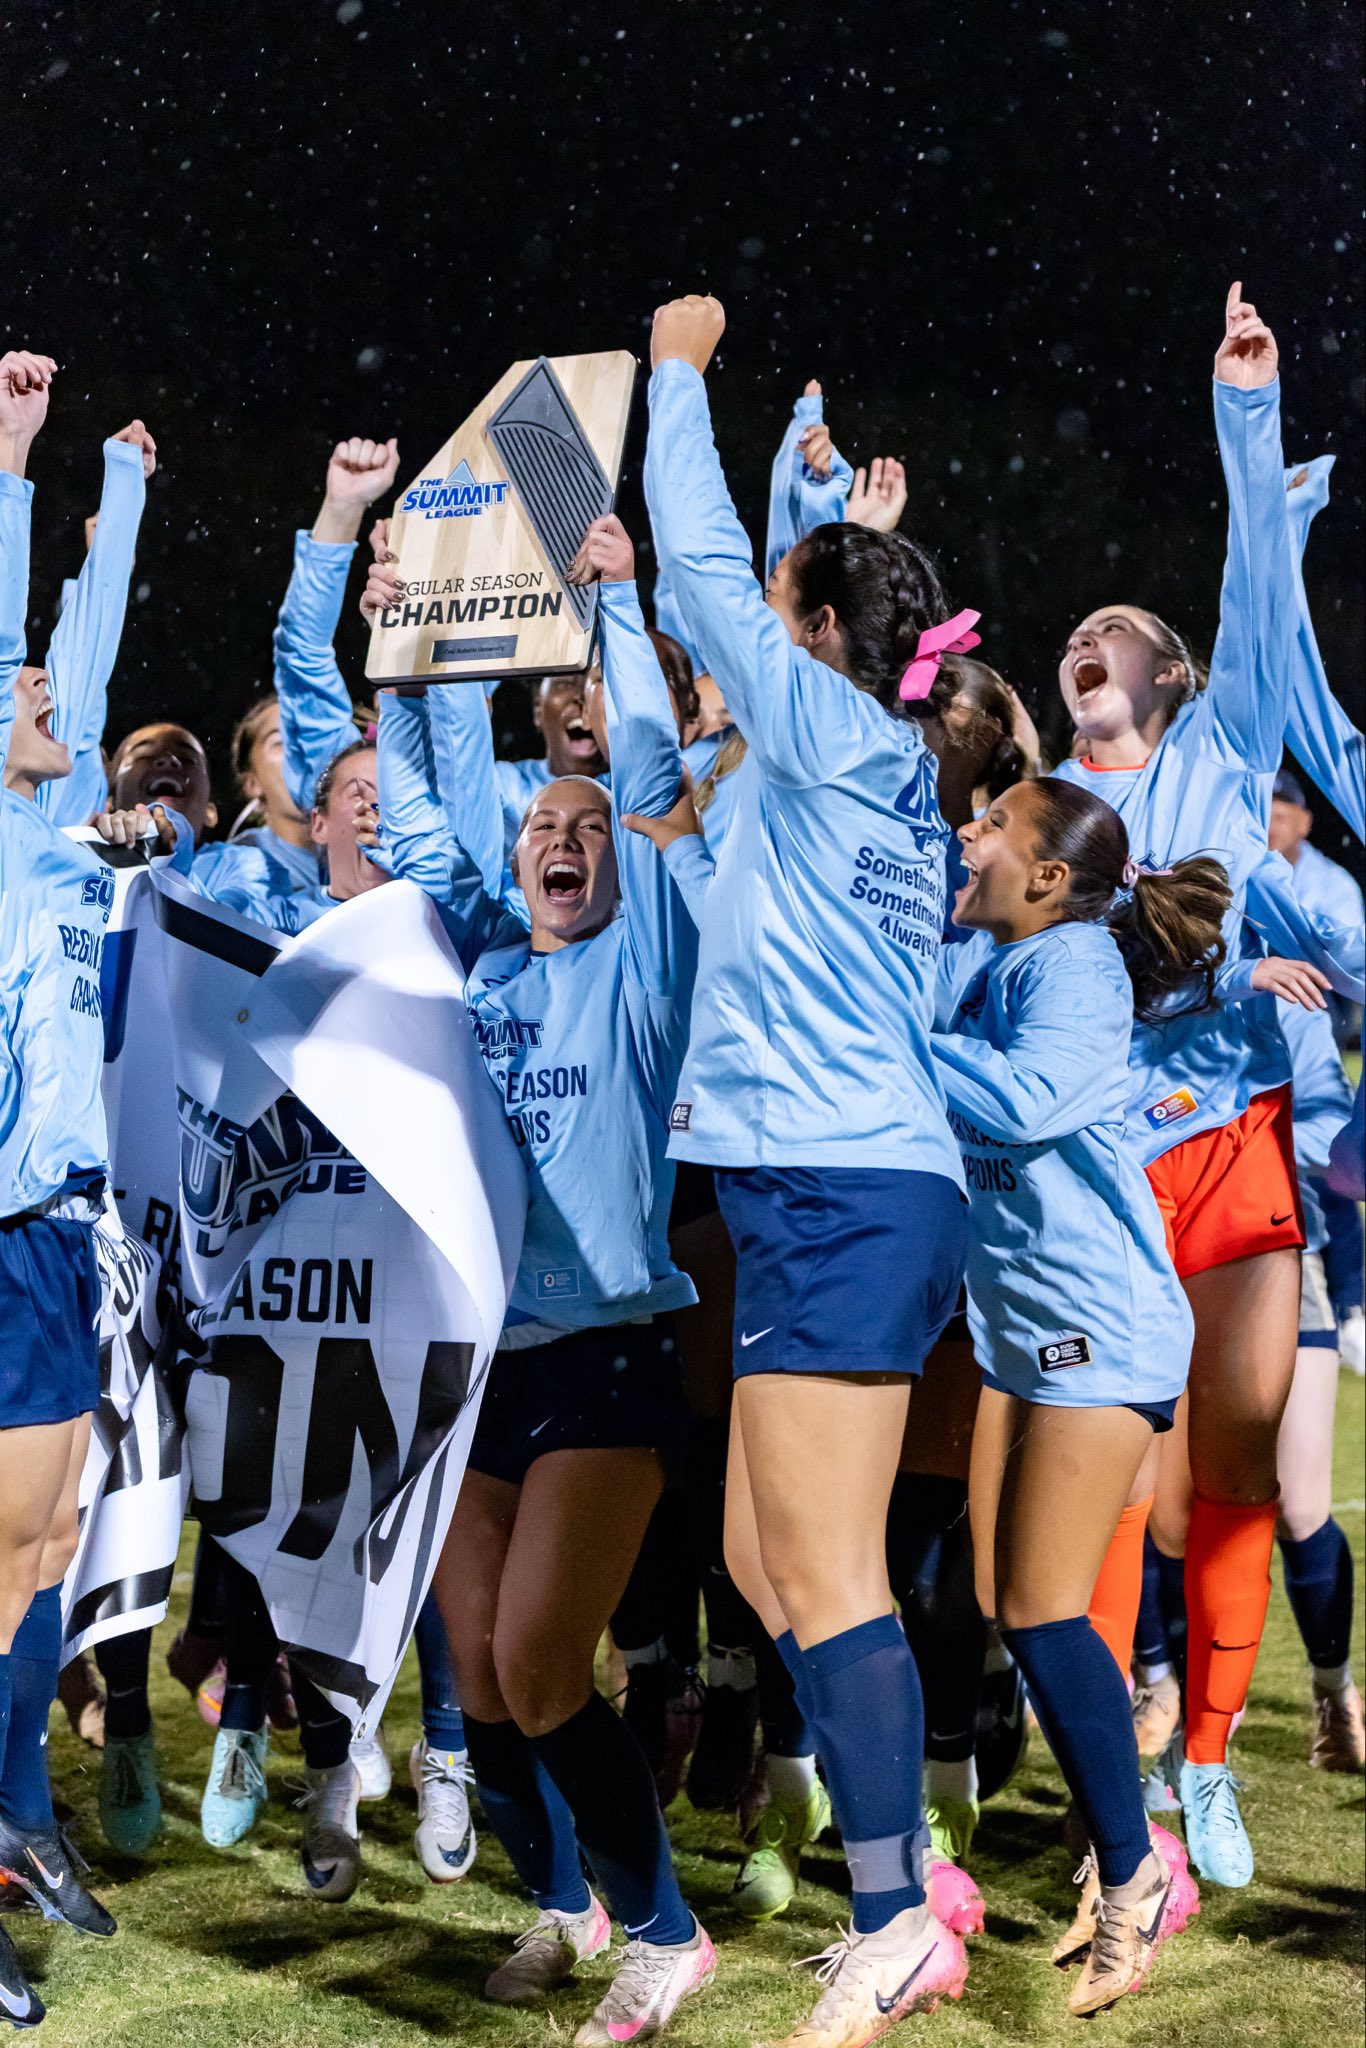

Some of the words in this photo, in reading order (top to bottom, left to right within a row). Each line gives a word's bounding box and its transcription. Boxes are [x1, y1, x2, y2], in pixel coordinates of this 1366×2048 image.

[402, 482, 508, 512] SUMMIT
[425, 507, 482, 519] LEAGUE
[406, 579, 465, 597] GULAR
[470, 572, 543, 592] SEASON
[380, 592, 563, 628] CHAMPION
[878, 915, 931, 957] Always
[473, 1020, 543, 1047] MMIT
[481, 1047, 519, 1059] AGUE
[177, 1084, 248, 1149] THE
[198, 1258, 373, 1325] ASON
